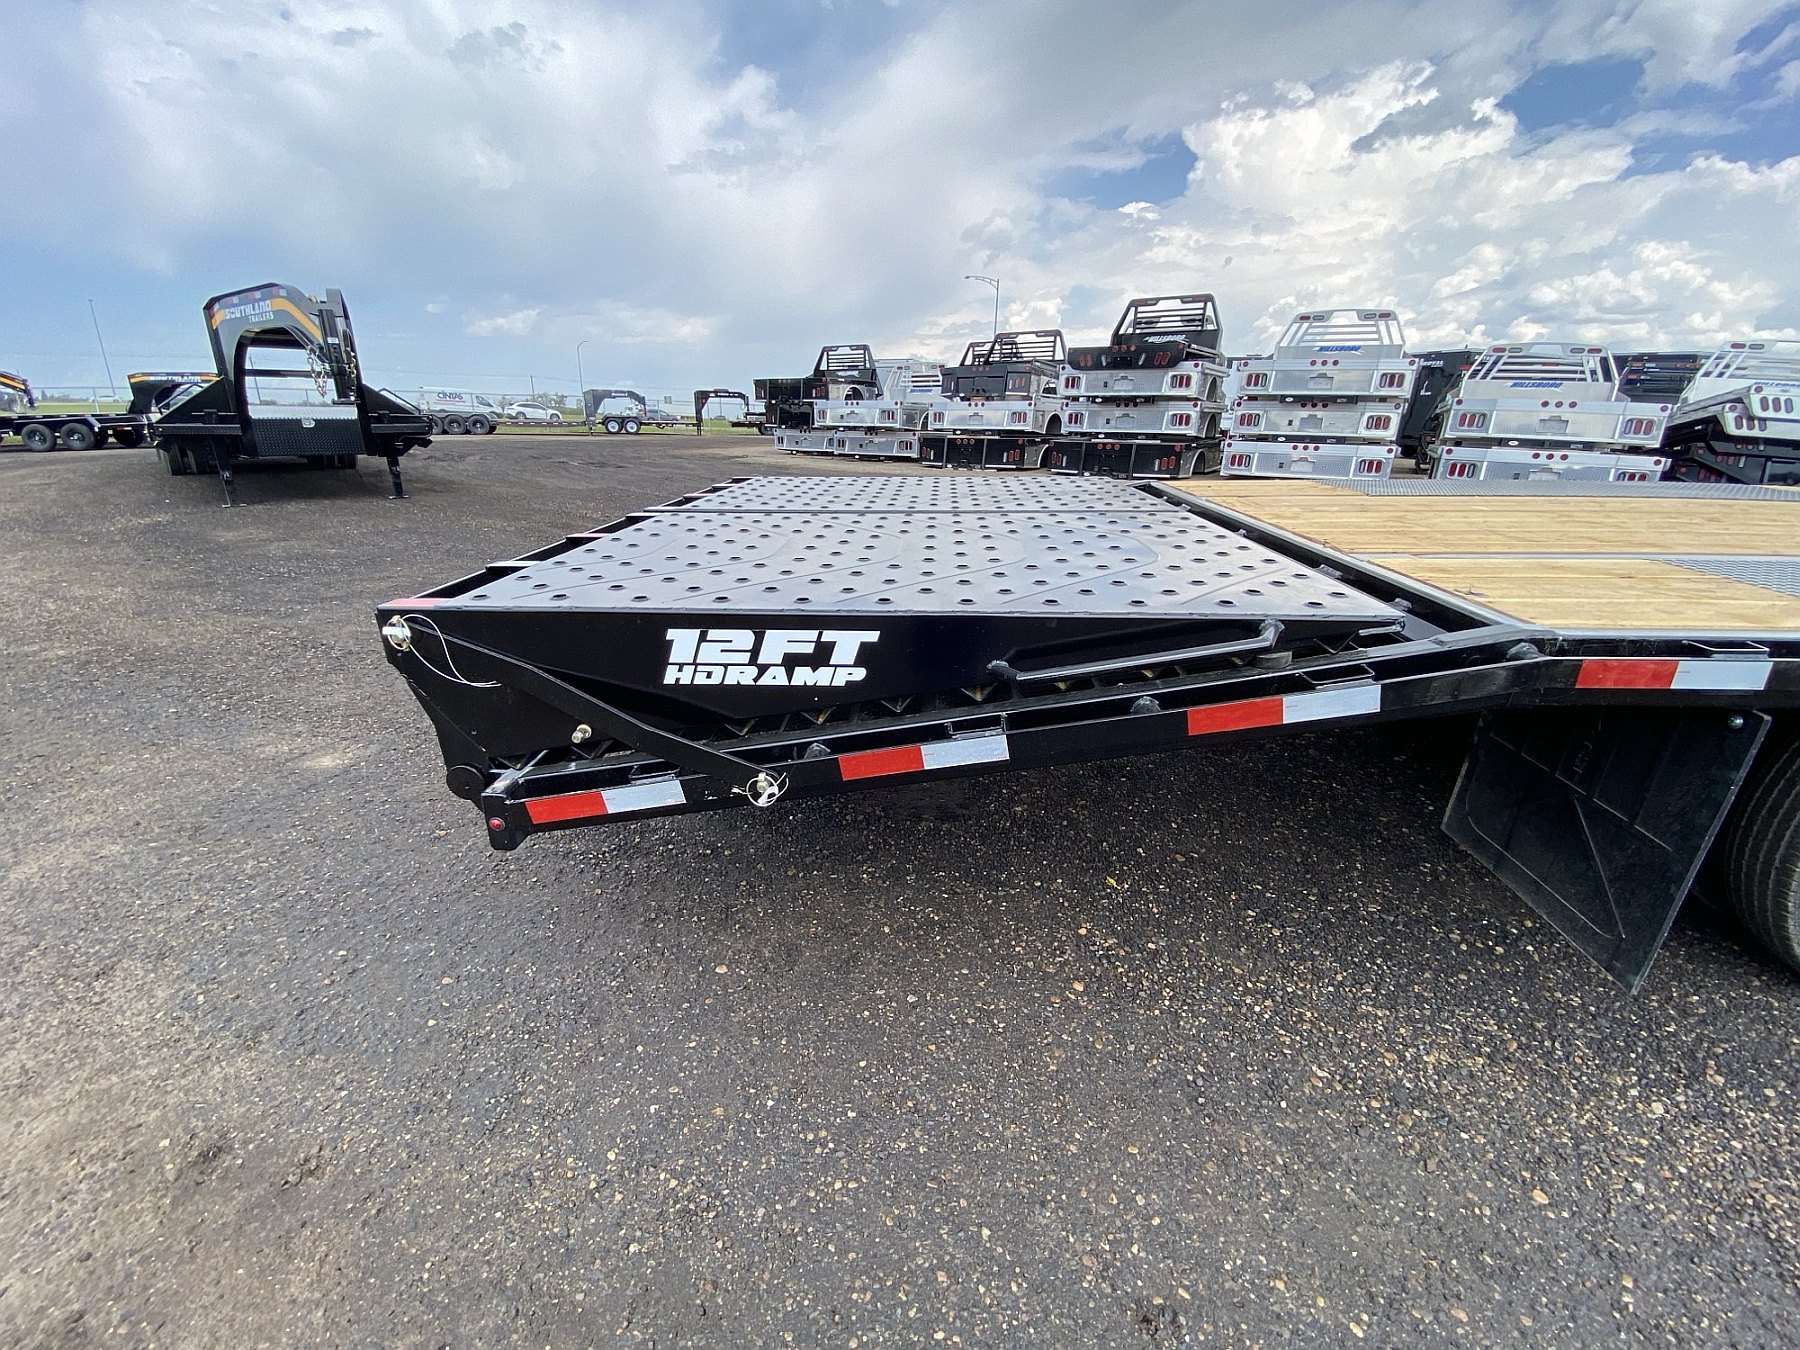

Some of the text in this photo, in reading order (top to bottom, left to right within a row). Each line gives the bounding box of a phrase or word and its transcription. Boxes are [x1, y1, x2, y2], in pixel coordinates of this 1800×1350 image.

[225, 300, 272, 320] SOUTHLAND
[437, 390, 464, 400] CINTAS
[666, 628, 880, 665] 12FT
[663, 665, 867, 686] HDRAMP
